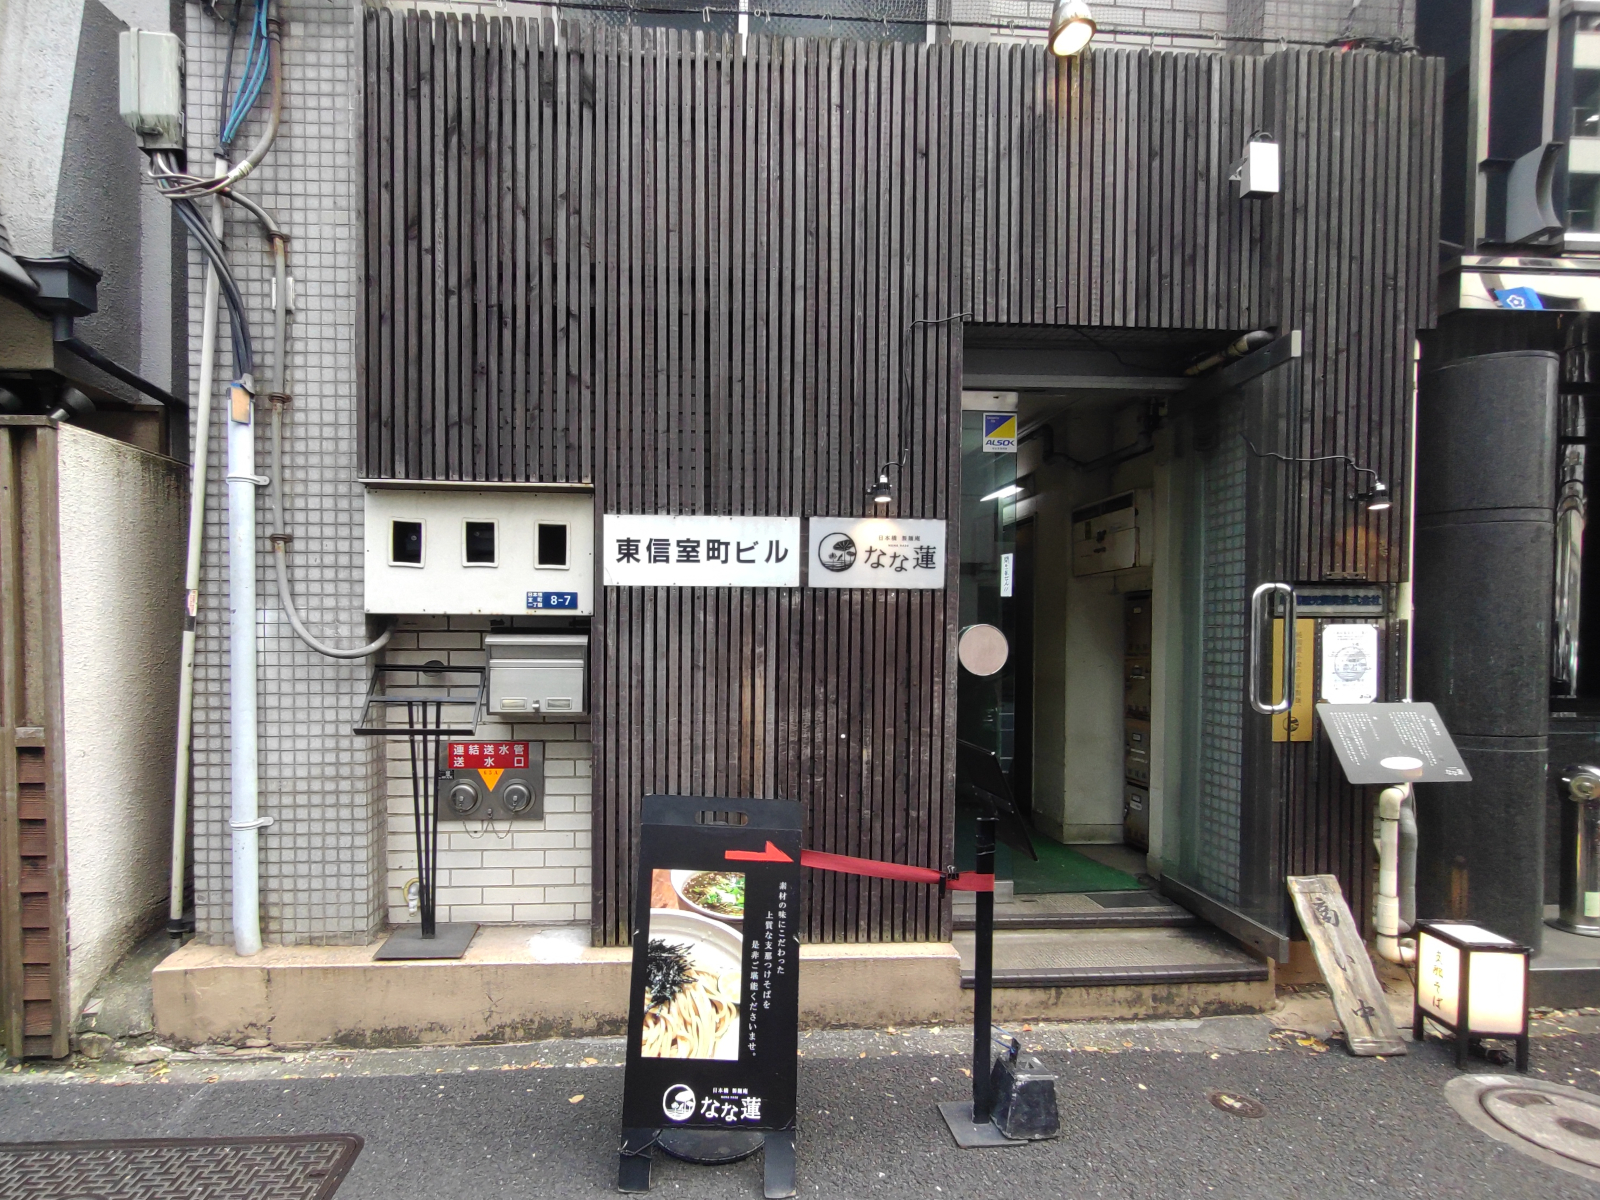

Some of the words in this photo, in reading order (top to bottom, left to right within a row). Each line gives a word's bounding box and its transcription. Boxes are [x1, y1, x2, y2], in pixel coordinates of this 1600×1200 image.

[616, 537, 789, 564] 東信室町ビル
[864, 545, 937, 572] なな蓮
[550, 595, 571, 606] 8-7
[453, 744, 524, 756] 連結送水管
[453, 757, 524, 767] 送水口
[776, 881, 788, 975] 素材の味にこだわった
[762, 910, 774, 1010] 上質な支那つけそばを
[1312, 897, 1376, 1036] 商い中
[1432, 950, 1444, 1011] 支那そば
[747, 939, 760, 1057] 是非ご堪能くださいませ。
[700, 1096, 762, 1122] なな蓮
